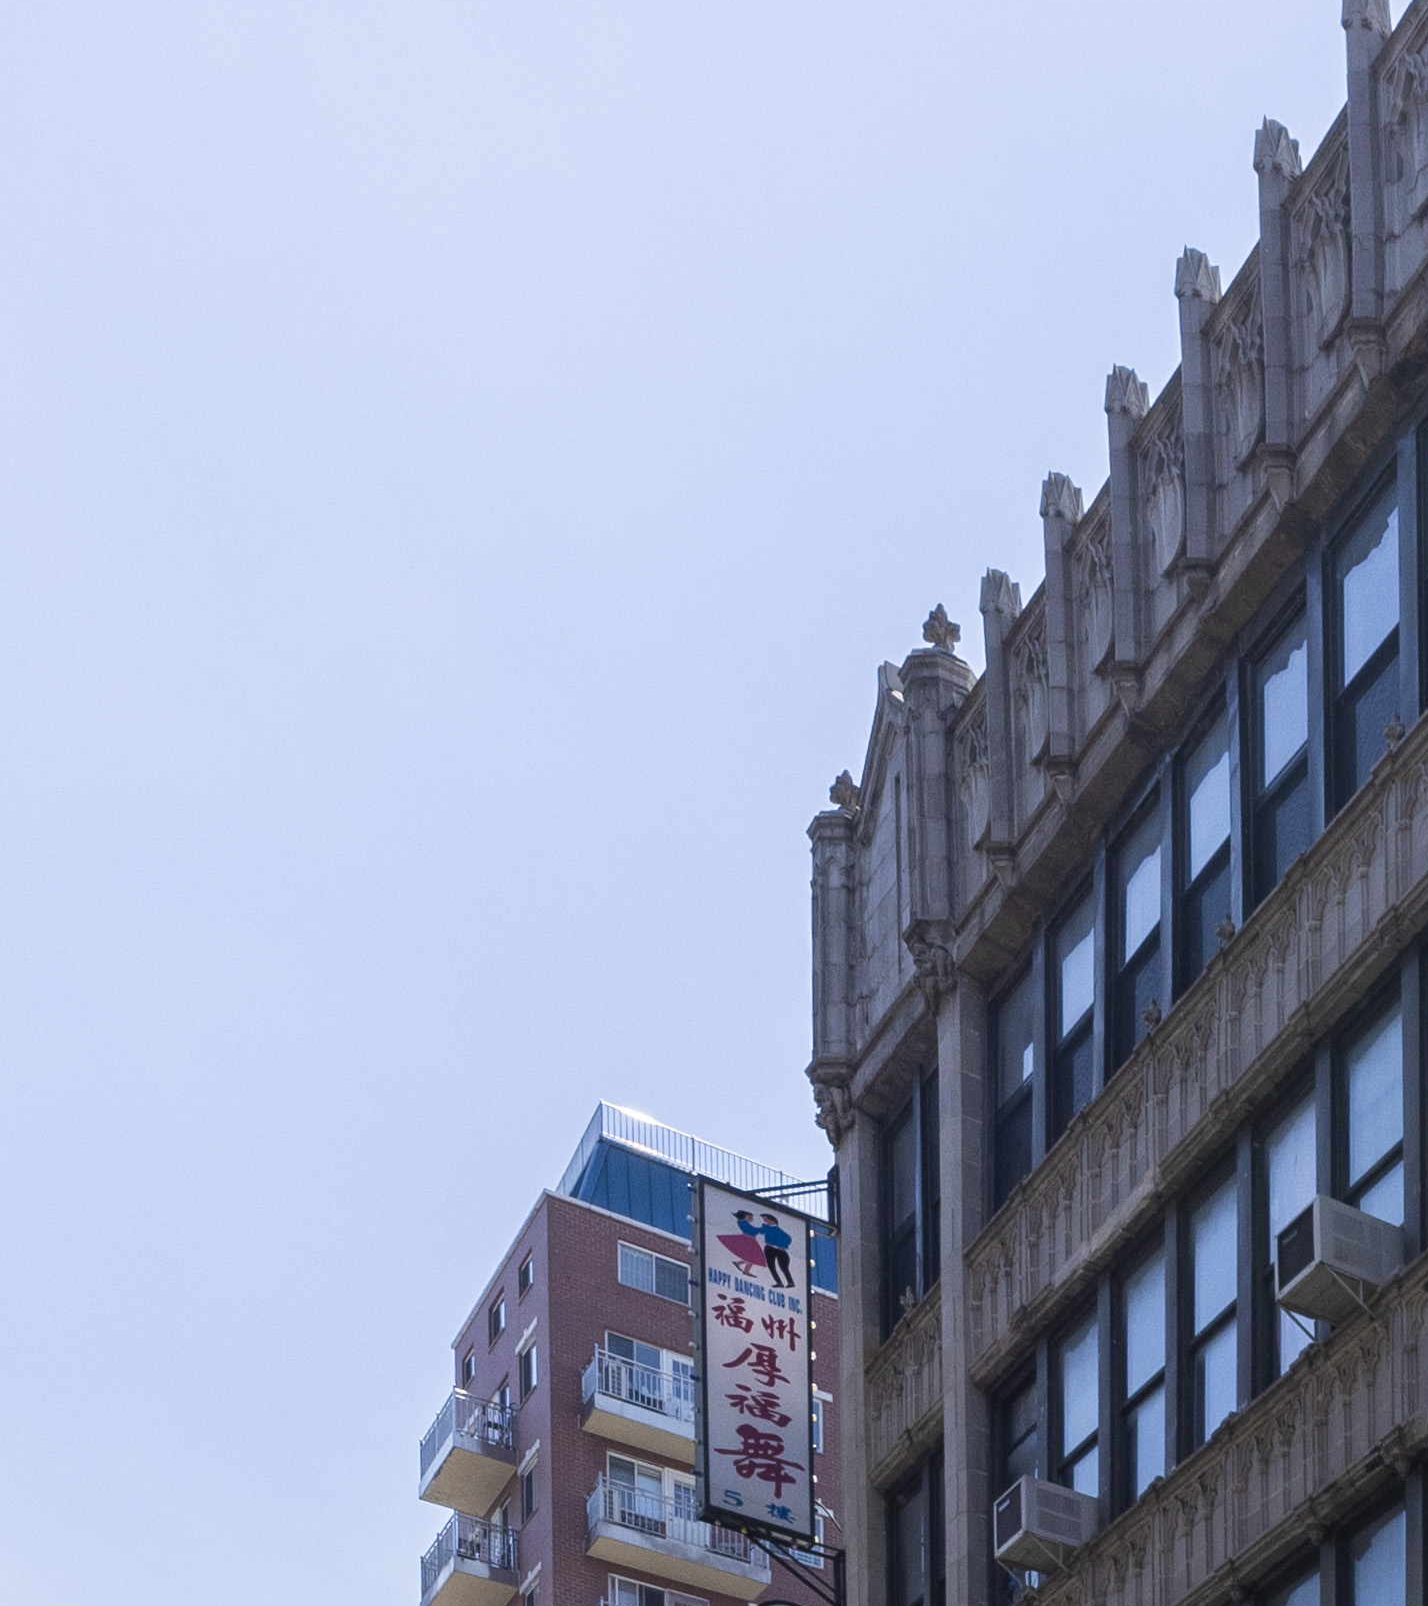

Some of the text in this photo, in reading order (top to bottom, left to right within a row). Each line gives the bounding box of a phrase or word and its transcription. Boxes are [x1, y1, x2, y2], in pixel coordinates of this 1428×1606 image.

[708, 1267, 731, 1289] HAPPY
[734, 1277, 766, 1302] DANCING
[768, 1288, 786, 1308] CLUB
